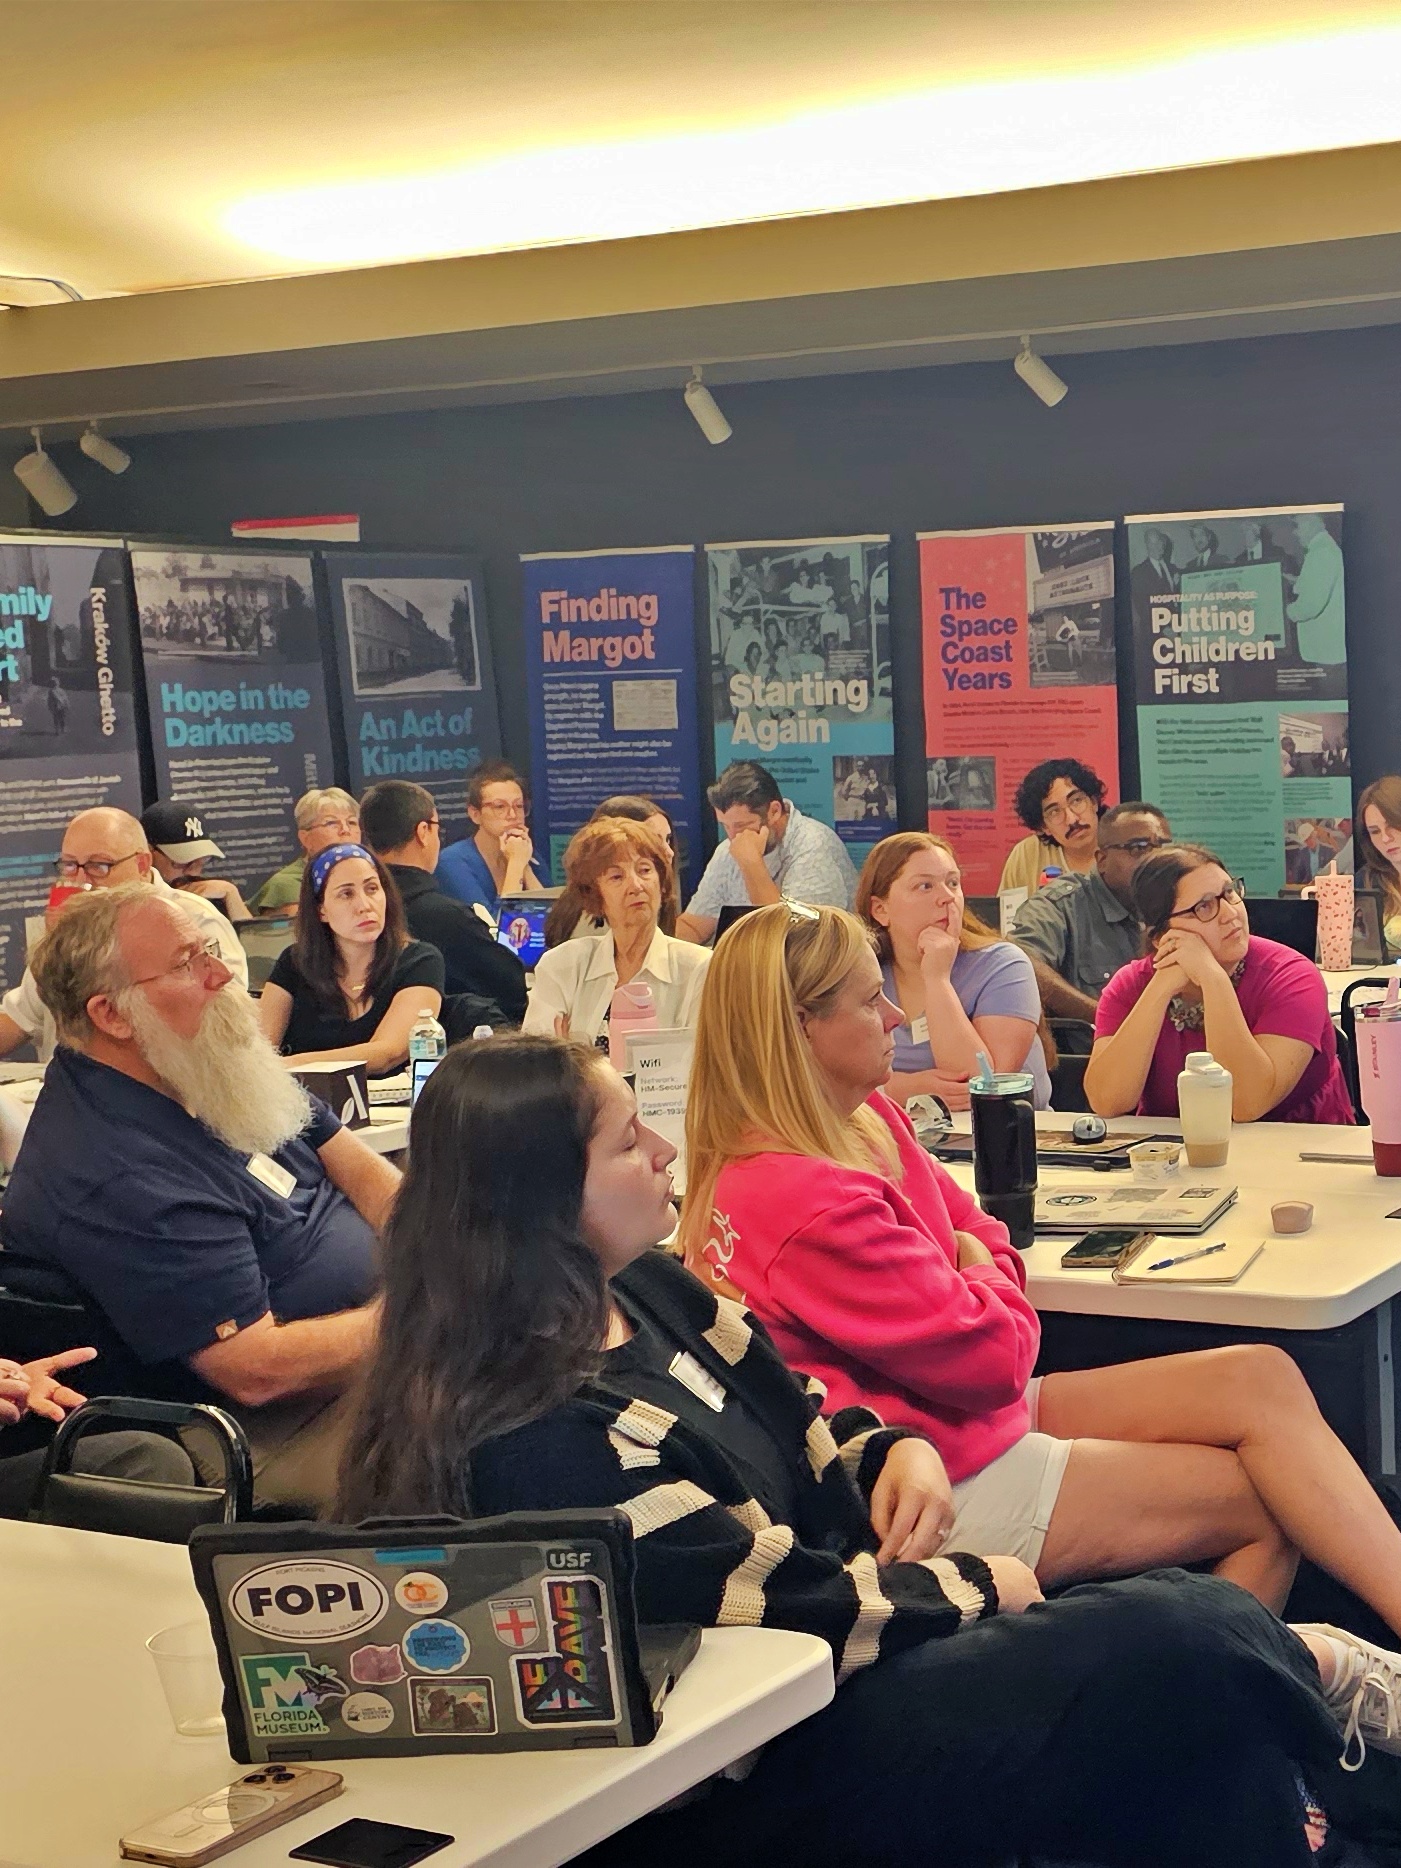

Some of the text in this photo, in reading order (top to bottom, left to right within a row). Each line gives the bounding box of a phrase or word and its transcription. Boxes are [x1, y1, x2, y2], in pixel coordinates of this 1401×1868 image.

[540, 587, 659, 627] Finding
[938, 586, 987, 611] The
[940, 613, 1018, 642] Space
[1151, 605, 1255, 636] Putting
[542, 628, 656, 668] Margot
[941, 640, 1013, 664] Coast
[1152, 636, 1275, 664] Children
[729, 671, 869, 713] Starting
[942, 667, 1013, 691] Years
[1154, 667, 1220, 694] First
[98, 667, 117, 736] Ghetto
[160, 682, 311, 718] Hope in the
[164, 716, 295, 748] Darkness
[360, 707, 473, 741] An Act of
[730, 710, 831, 752] Again
[361, 743, 481, 777] Kindness
[639, 1059, 661, 1068] Wifi
[550, 1552, 592, 1569] USF
[246, 1581, 365, 1618] FOPI
[253, 1710, 319, 1723] FLORIDA
